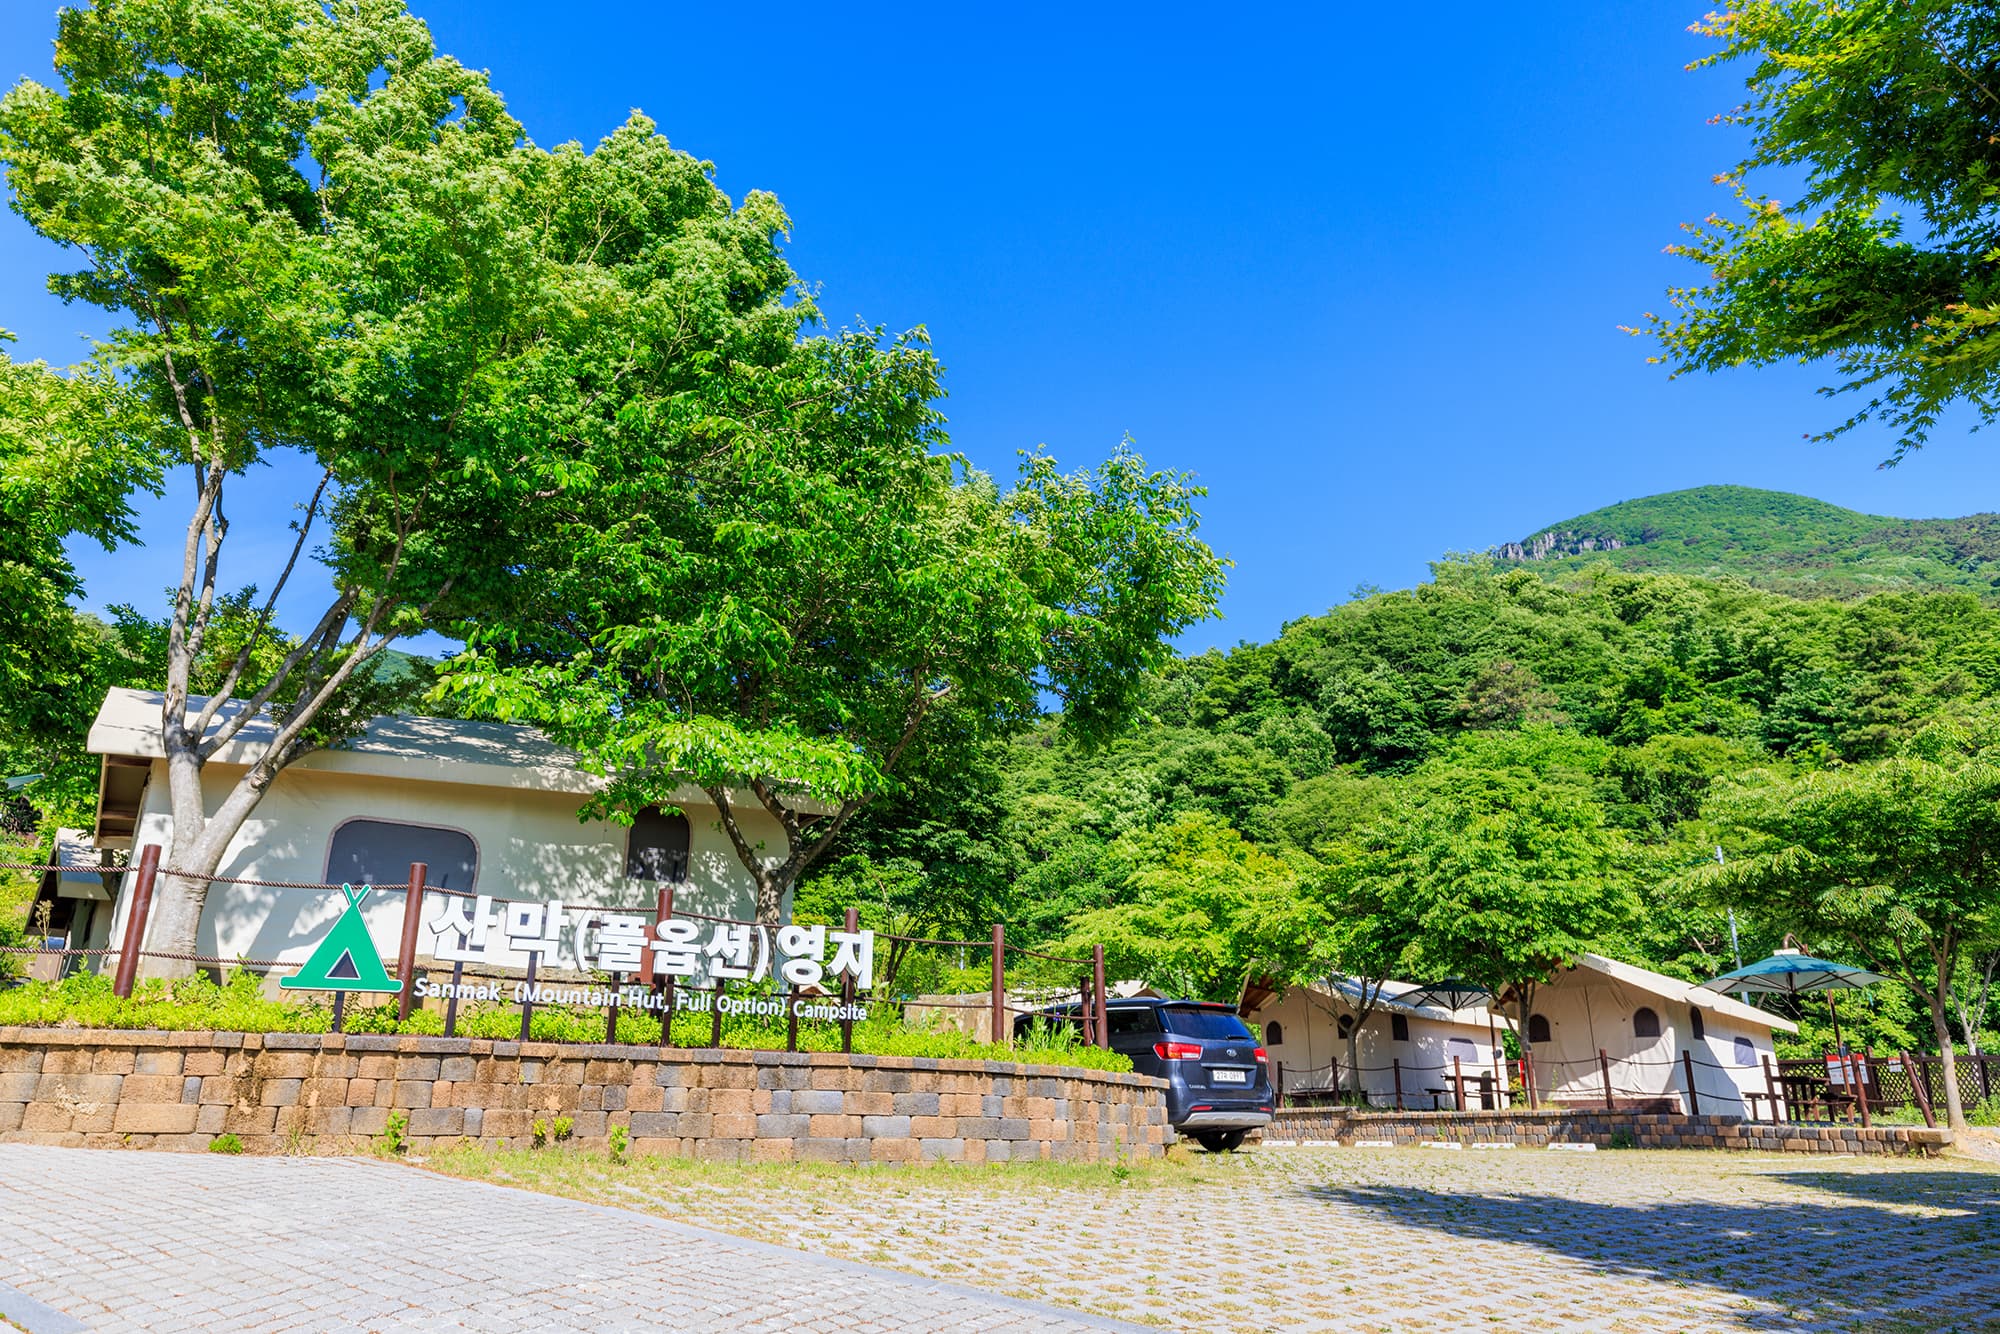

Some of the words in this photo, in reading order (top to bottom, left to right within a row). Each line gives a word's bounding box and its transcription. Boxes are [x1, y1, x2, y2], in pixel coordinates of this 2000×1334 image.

[413, 977, 501, 1000] Sanmak
[515, 981, 621, 1007] (Mountain
[627, 989, 669, 1013] Hut,
[676, 992, 710, 1012] Full
[716, 995, 785, 1017] Option)
[793, 1000, 868, 1022] Campsite
